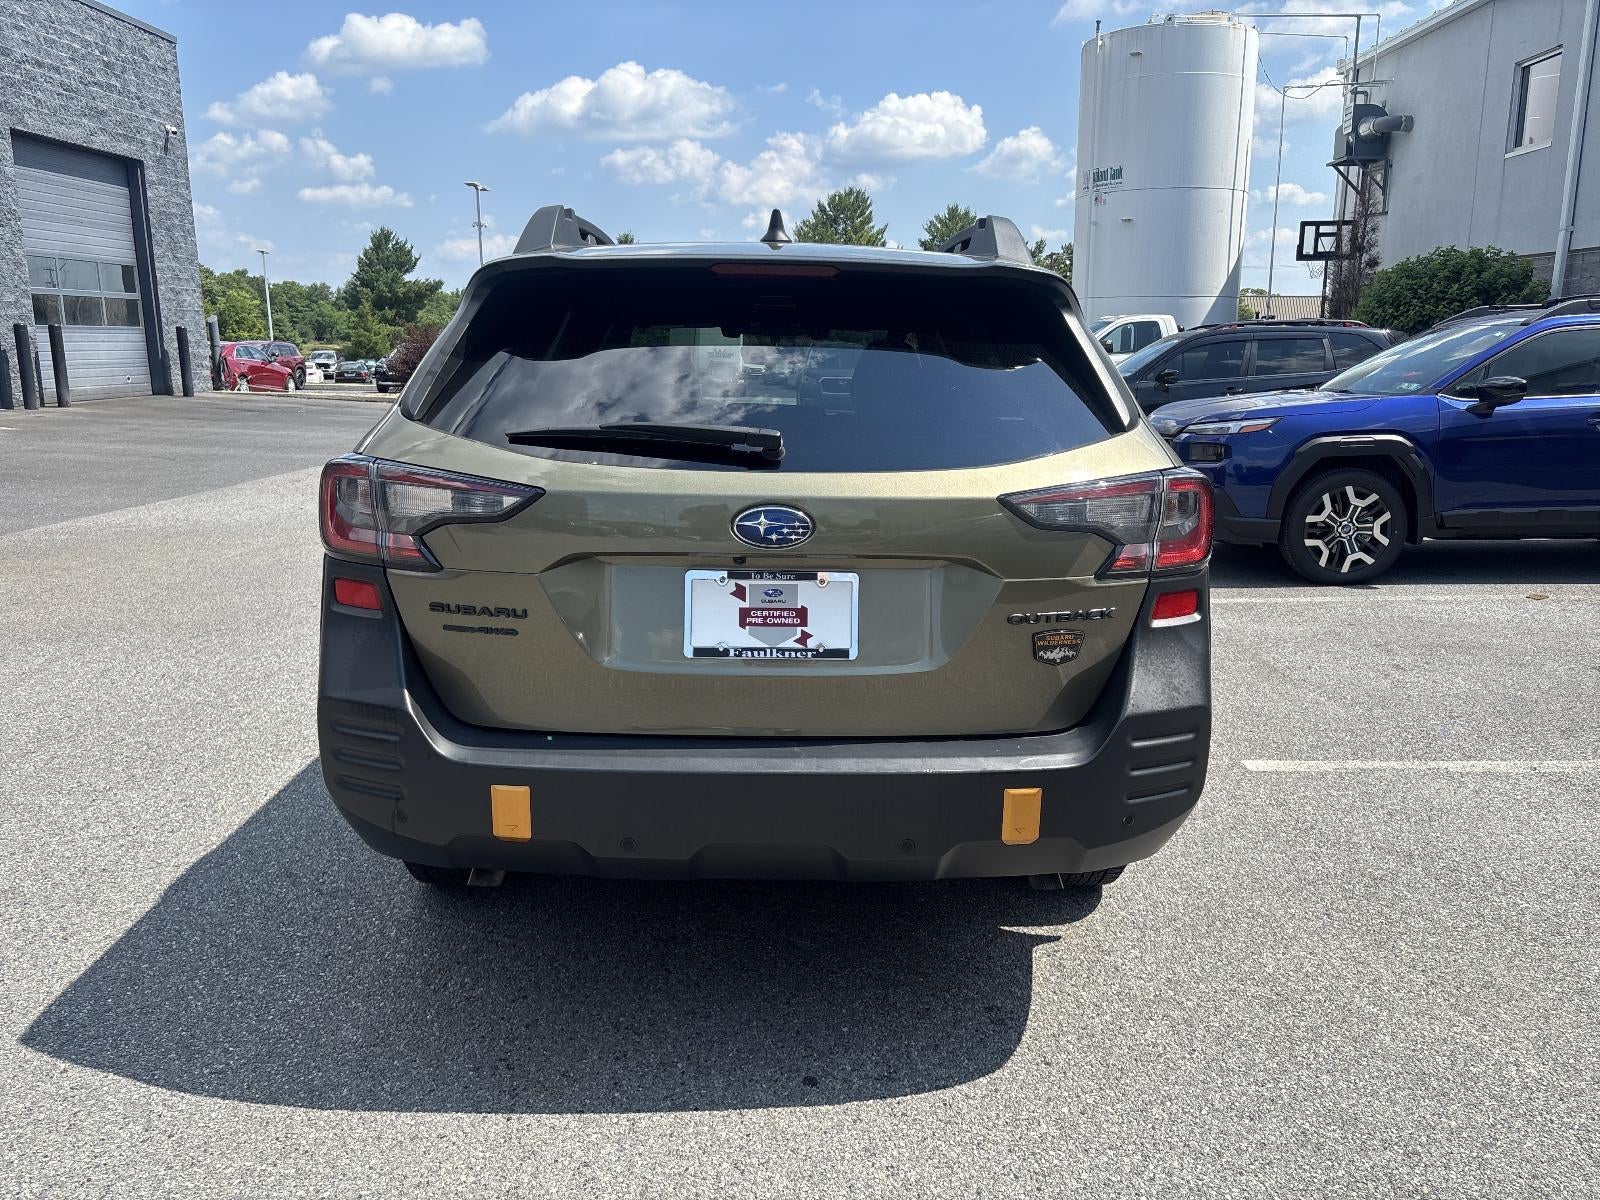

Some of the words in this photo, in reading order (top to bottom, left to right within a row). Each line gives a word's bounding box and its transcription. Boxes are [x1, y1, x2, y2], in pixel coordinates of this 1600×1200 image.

[1109, 165, 1123, 180] Tank
[751, 572, 760, 580] To
[763, 572, 774, 580] Be
[776, 572, 796, 580] Sure
[428, 601, 528, 619] SUBARU
[1007, 607, 1116, 625] OUTBACK
[728, 648, 817, 659] Faulkner
